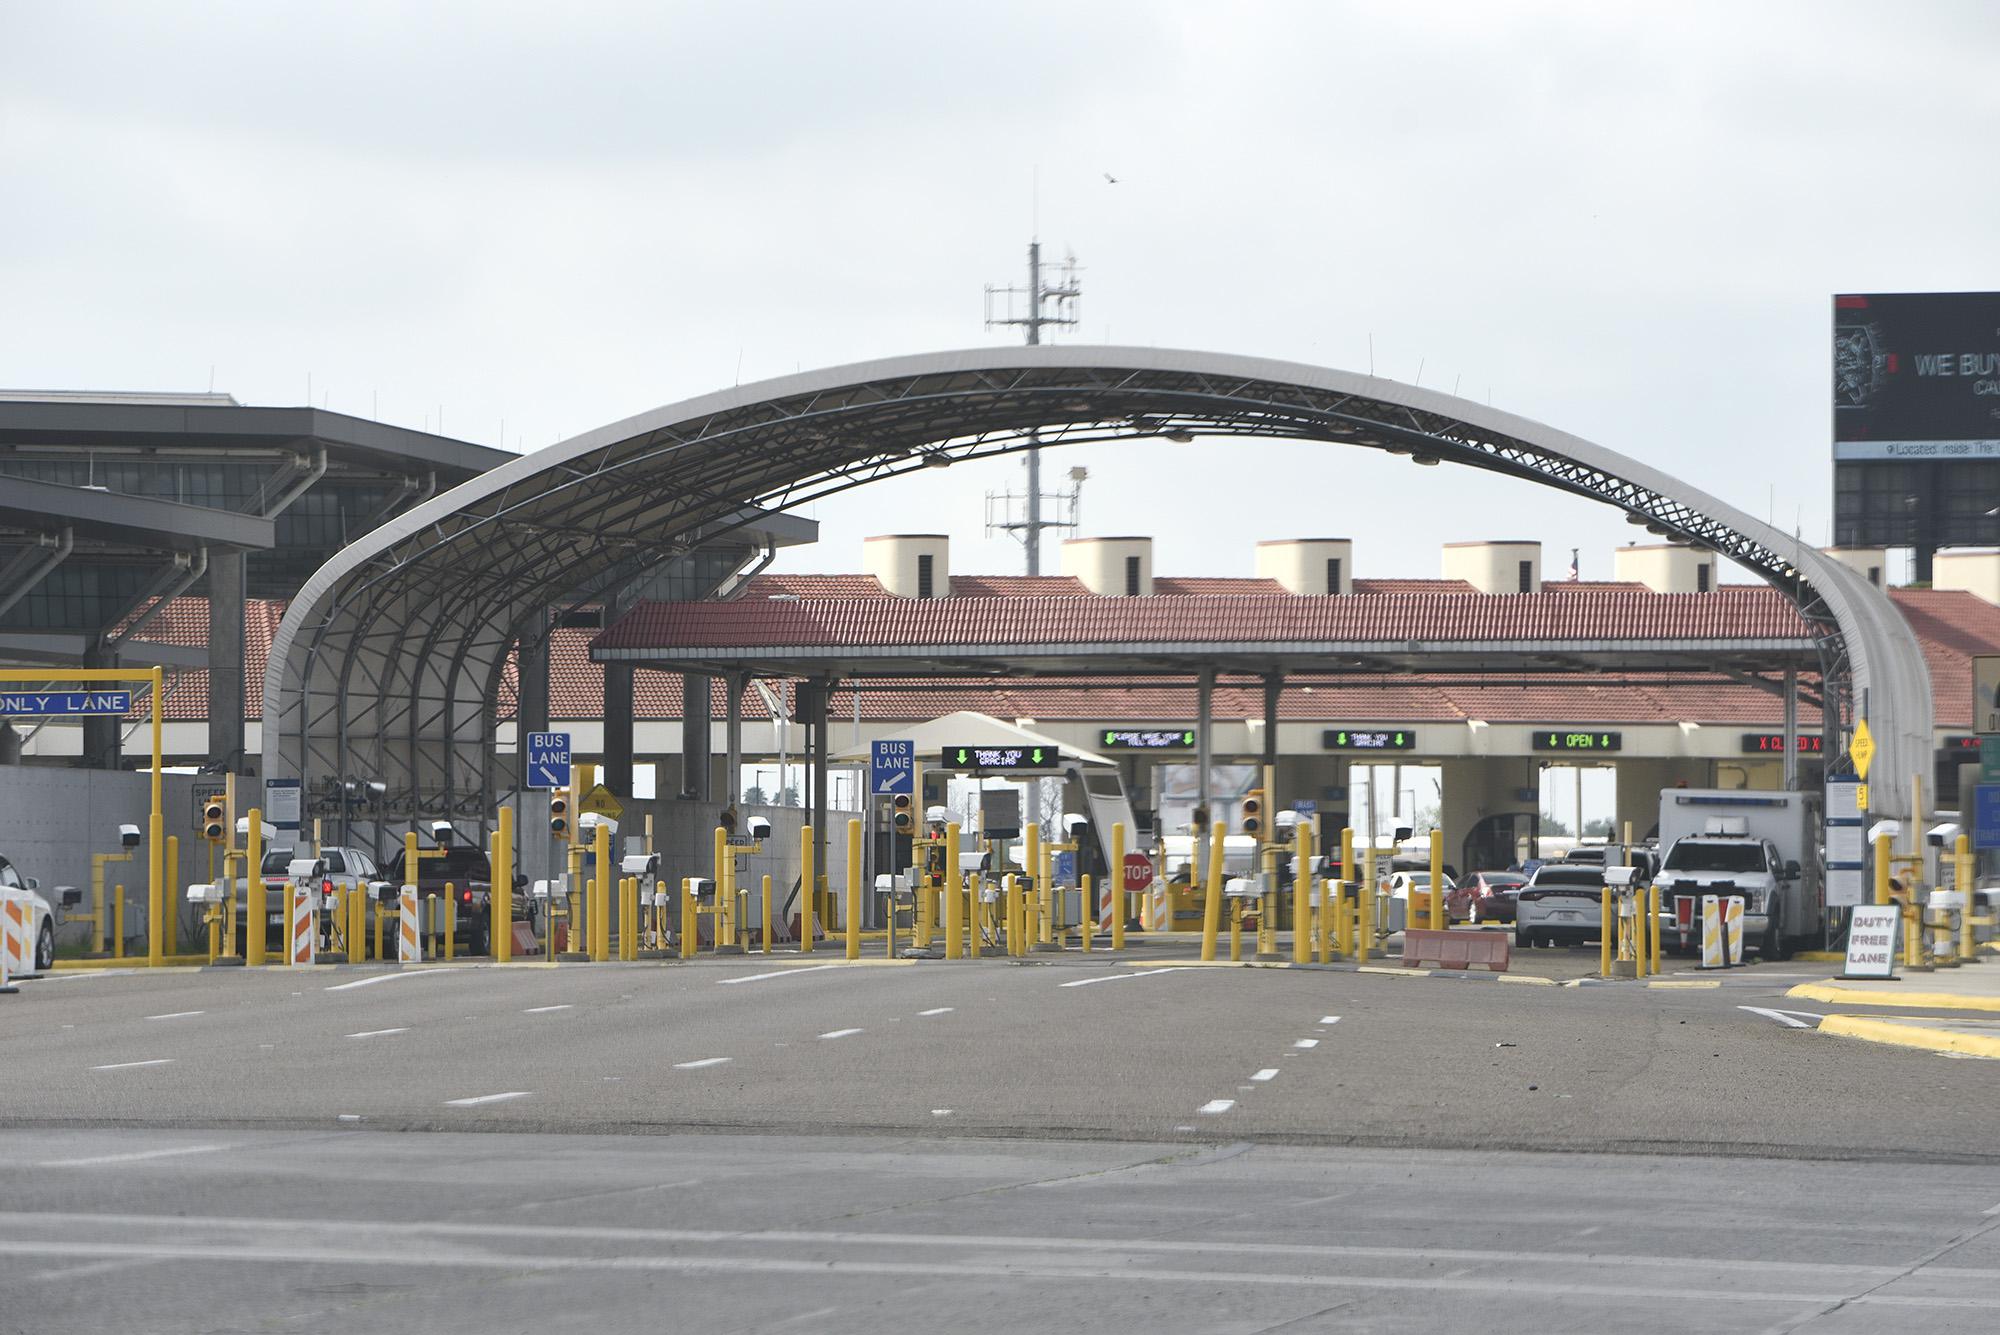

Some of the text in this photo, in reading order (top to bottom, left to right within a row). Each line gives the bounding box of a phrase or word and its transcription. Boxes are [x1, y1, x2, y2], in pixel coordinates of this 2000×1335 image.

[1914, 353, 1955, 376] WE
[67, 695, 124, 711] LANE
[534, 735, 564, 748] BUS
[1566, 734, 1593, 748] OPEN
[880, 743, 907, 754] BUS
[974, 750, 1022, 759] THANK YOU
[529, 751, 569, 765] LANE
[876, 757, 910, 769] LANE
[979, 758, 1016, 766] GRACIAS
[1123, 865, 1152, 880] TOP
[1853, 916, 1894, 928] DUTY
[1851, 934, 1889, 946] FREE
[1849, 953, 1888, 964] LANE
